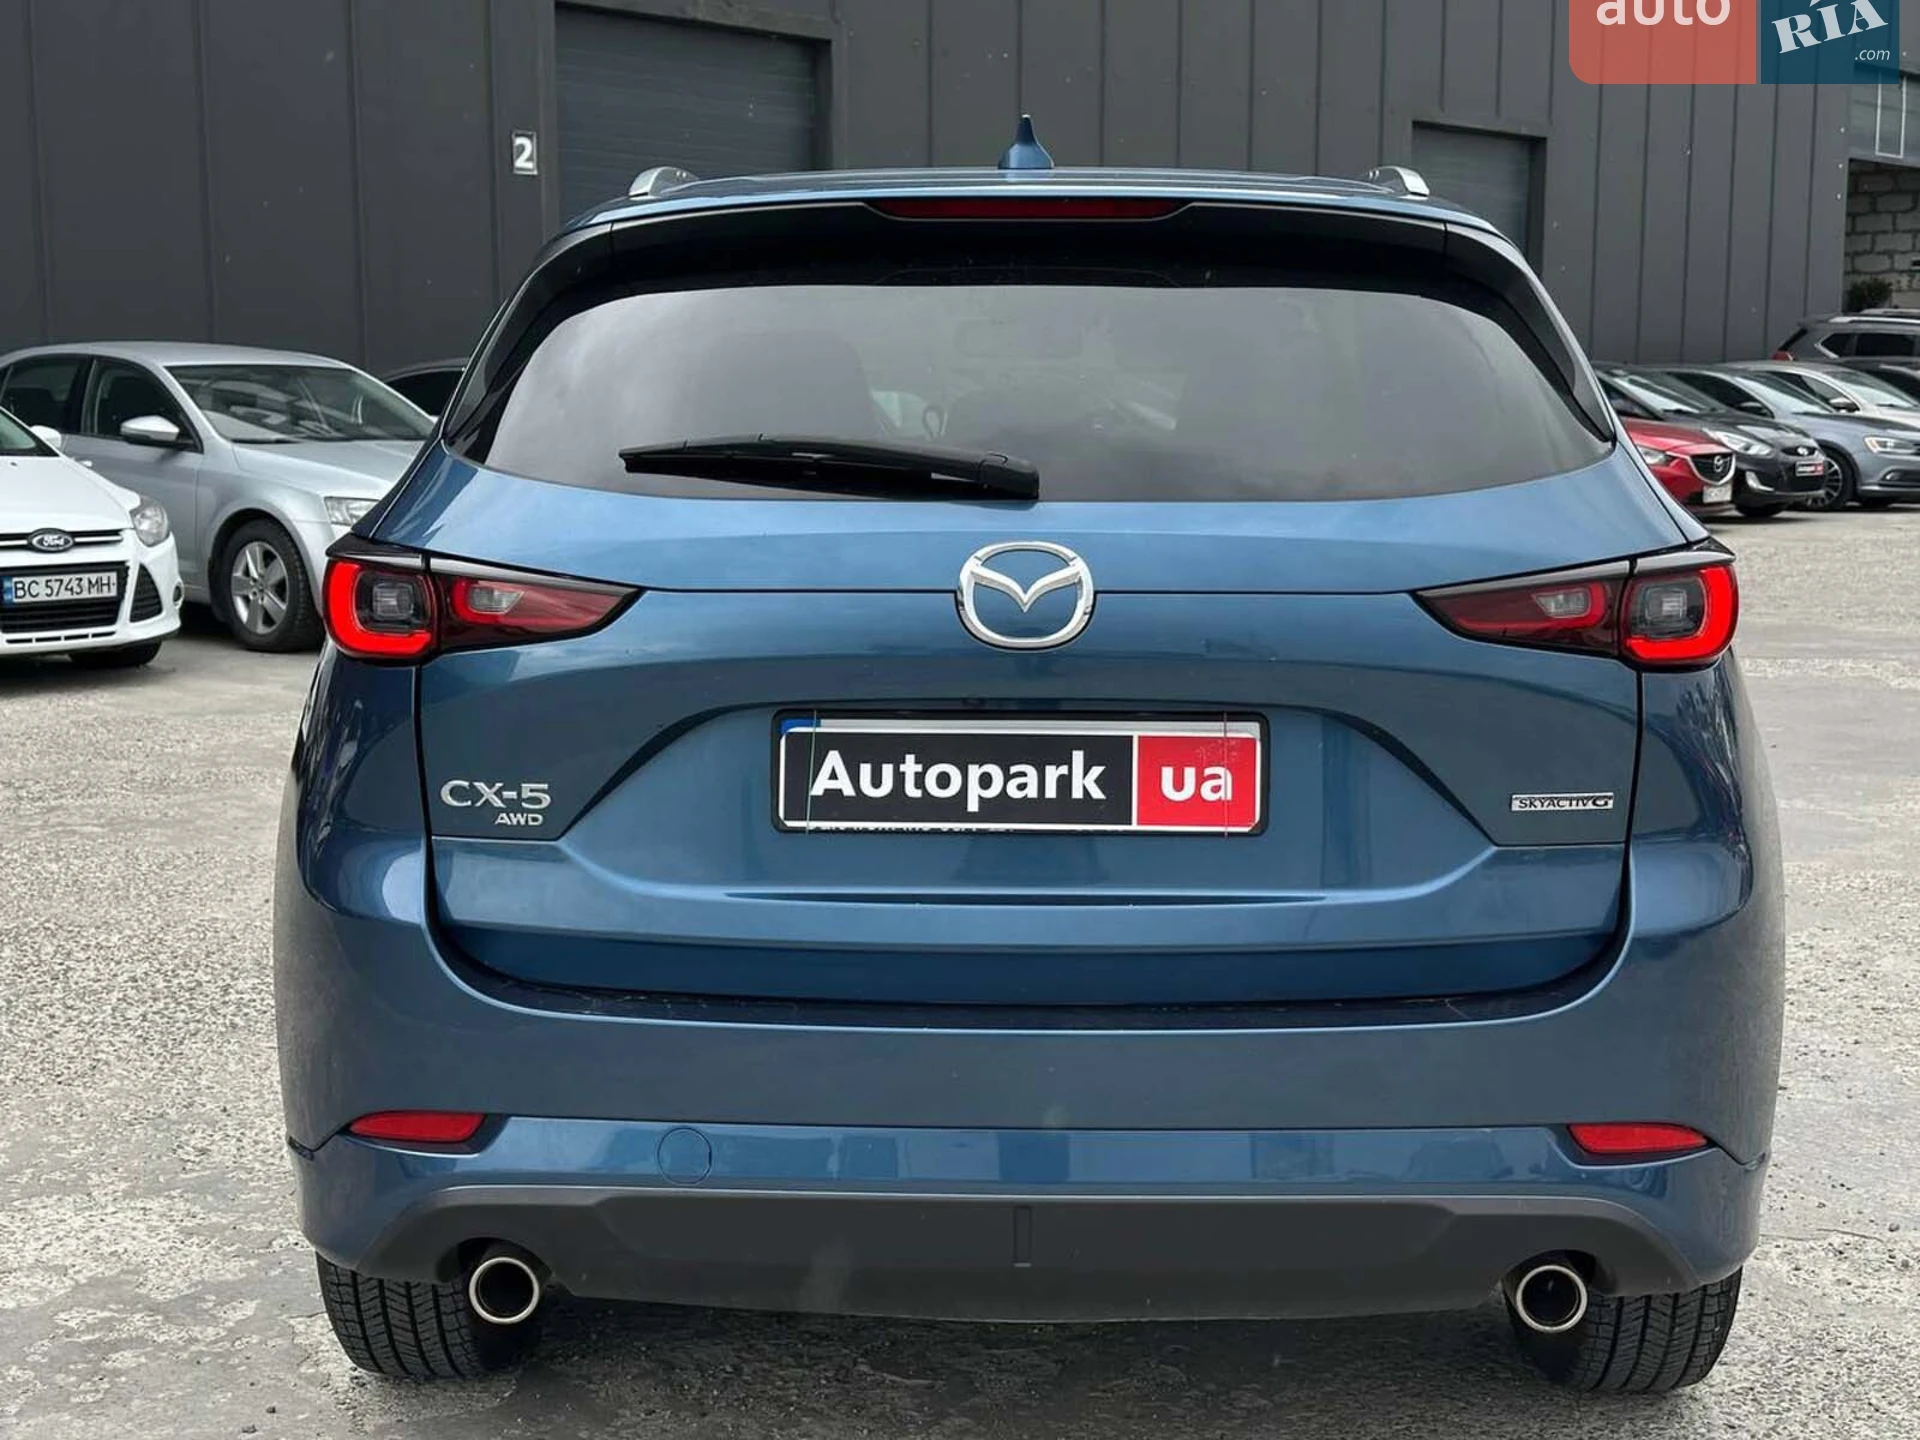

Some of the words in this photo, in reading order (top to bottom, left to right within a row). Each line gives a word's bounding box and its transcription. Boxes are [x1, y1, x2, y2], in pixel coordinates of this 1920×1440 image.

[514, 136, 533, 169] 2
[14, 579, 40, 599] BC
[45, 577, 83, 597] 5743
[88, 575, 111, 595] MH
[440, 780, 551, 809] CX-5
[811, 749, 1107, 812] Autopark
[1160, 765, 1234, 801] ua
[495, 812, 543, 825] AWD
